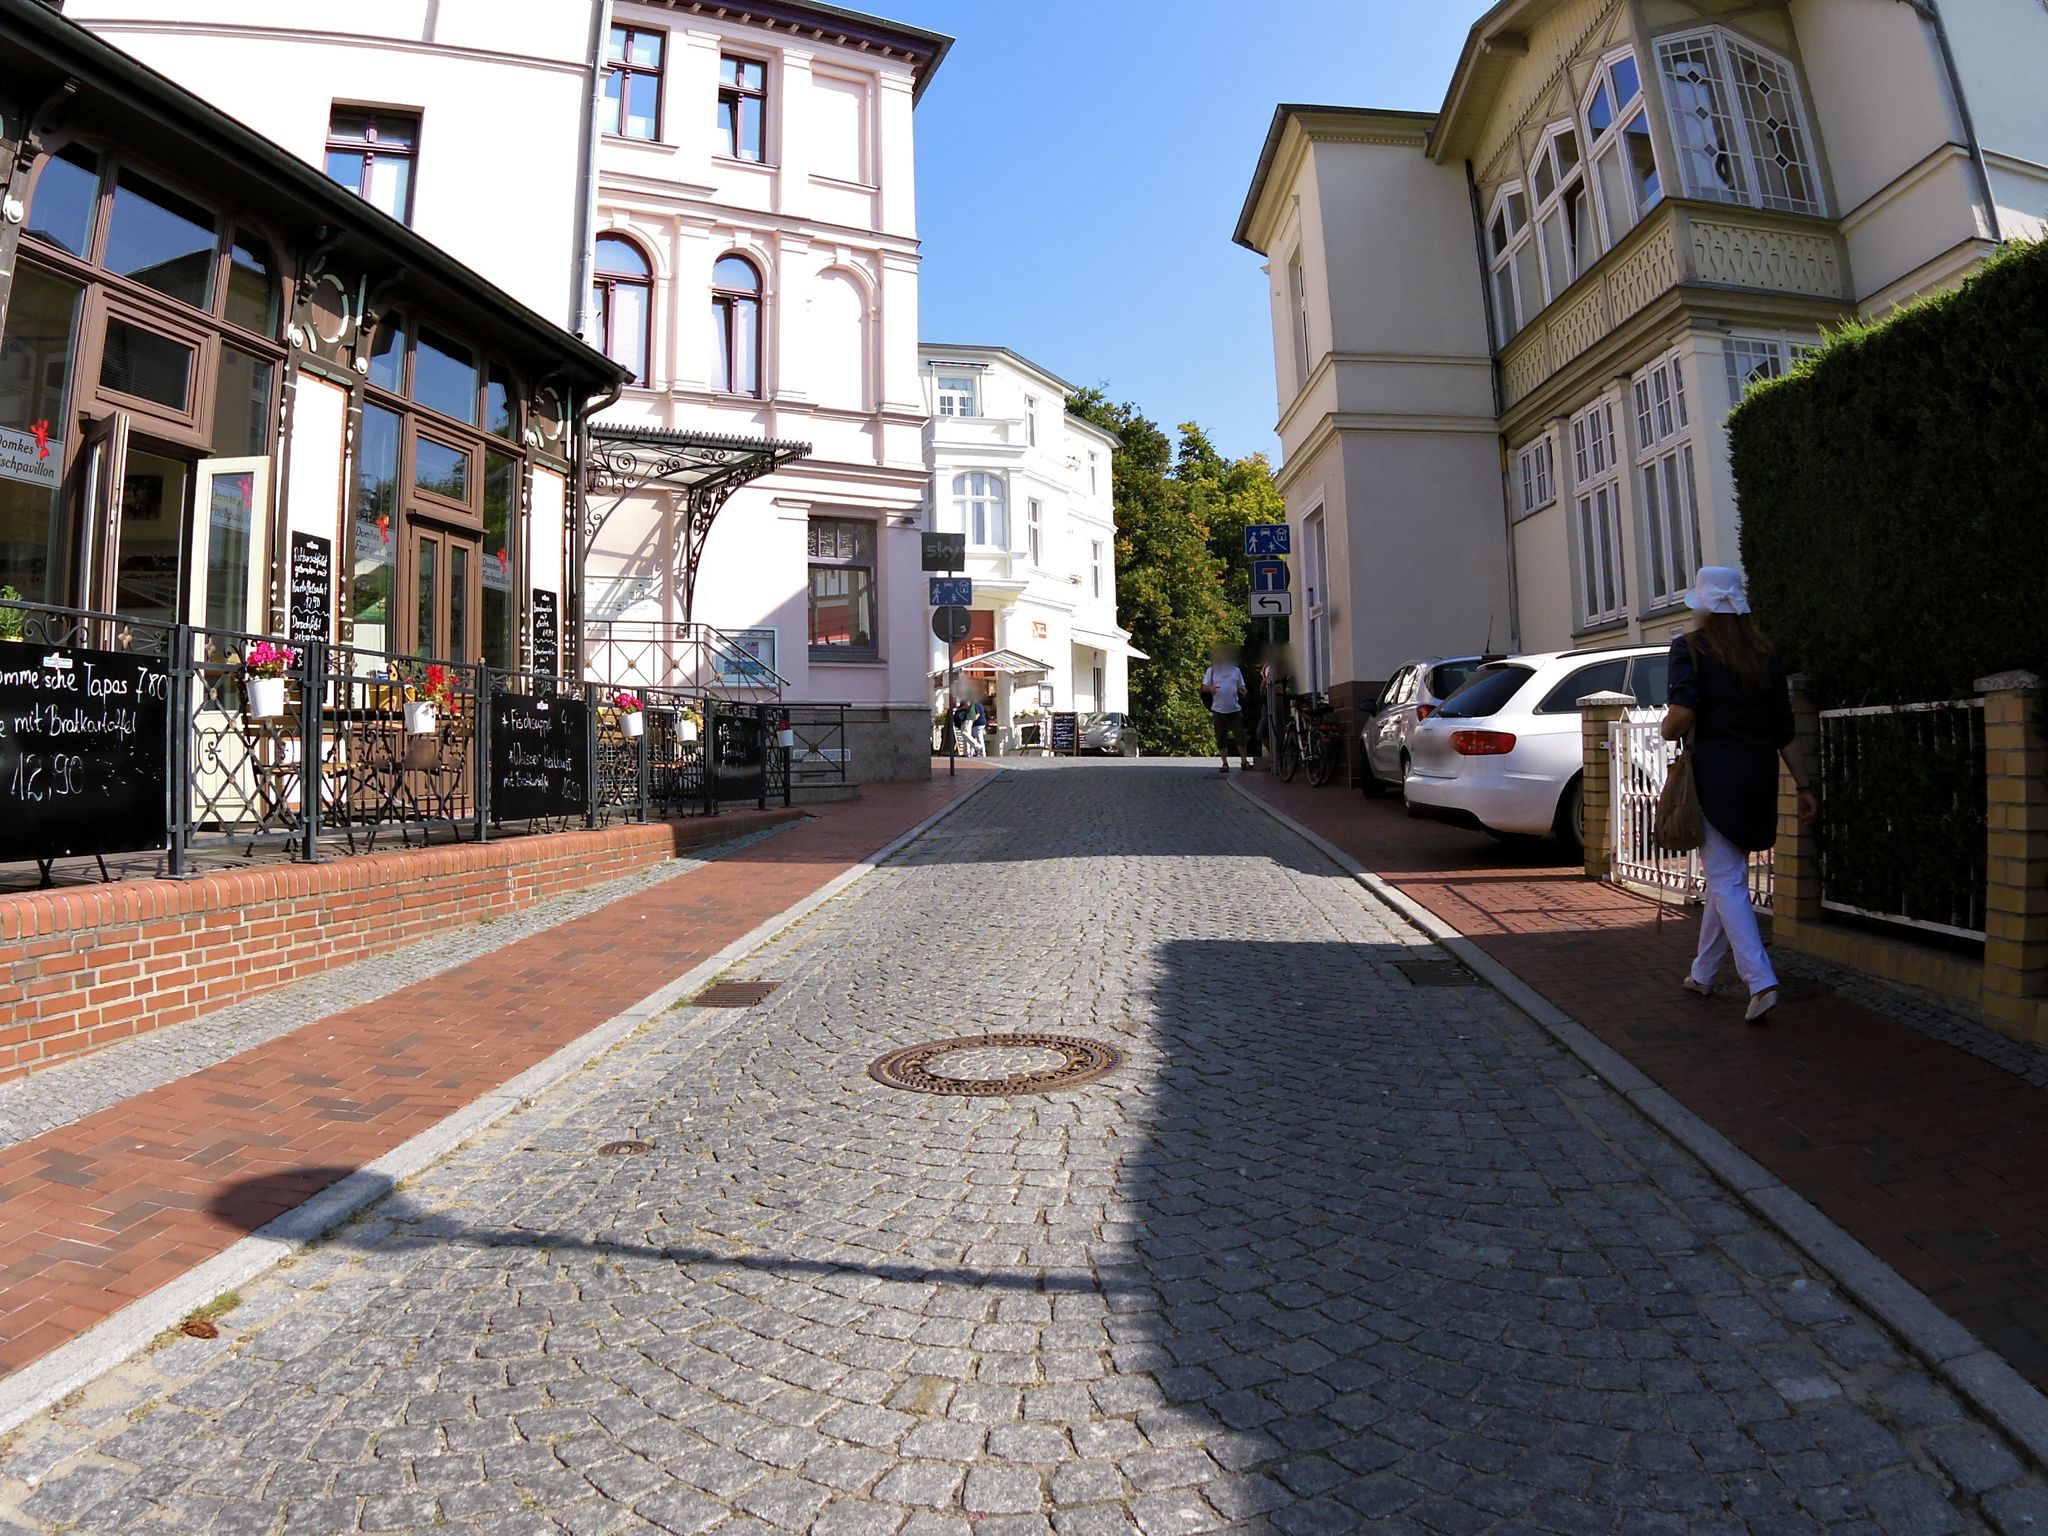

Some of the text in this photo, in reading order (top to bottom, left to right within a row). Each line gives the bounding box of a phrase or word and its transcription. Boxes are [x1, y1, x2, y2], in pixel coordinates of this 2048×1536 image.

[0, 454, 55, 479] schpavillon
[926, 540, 960, 562] sky
[84, 661, 128, 707] Tapas
[14, 702, 43, 733] mit
